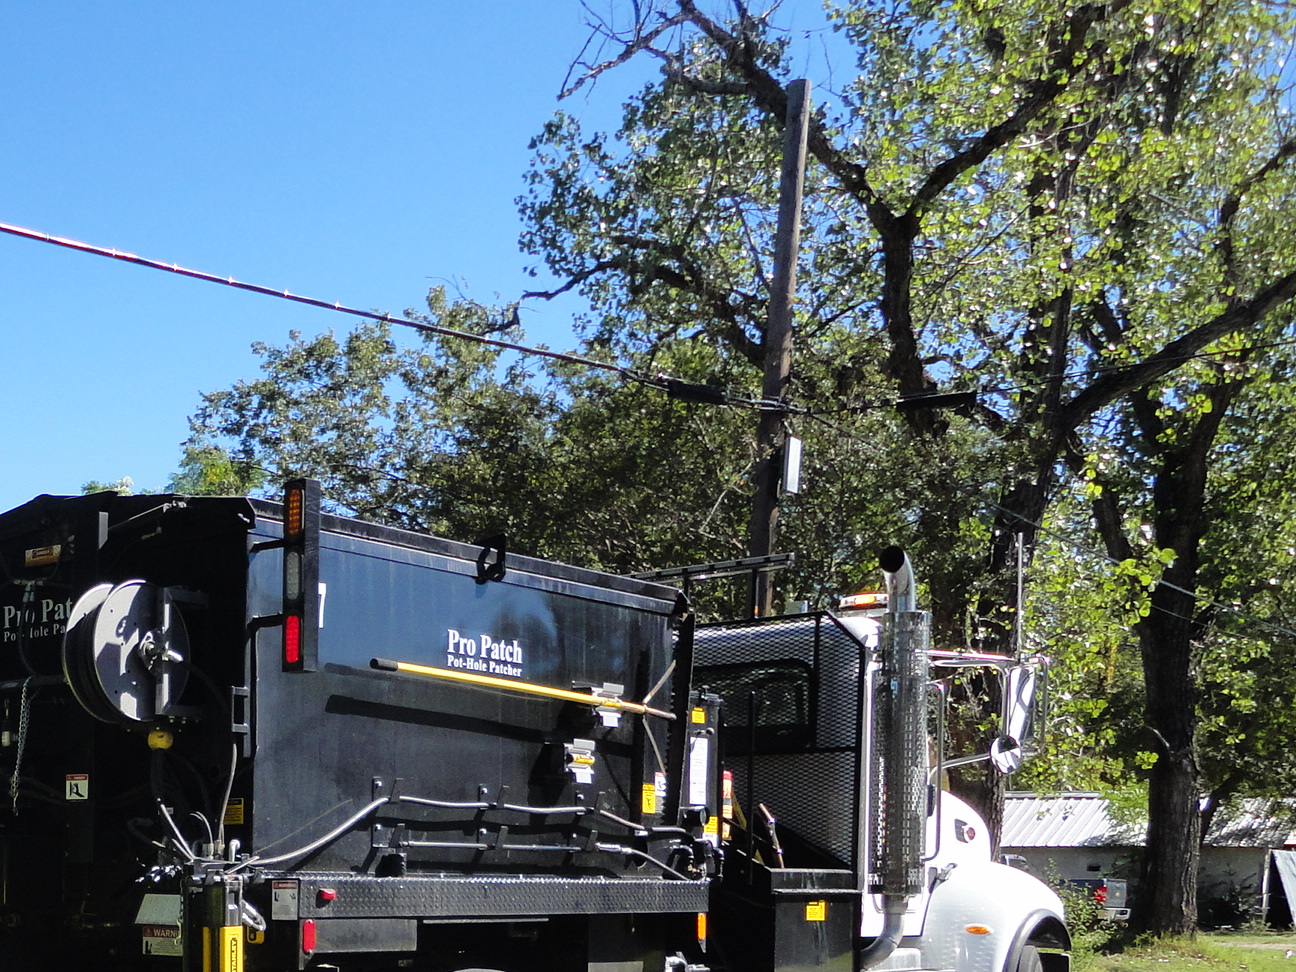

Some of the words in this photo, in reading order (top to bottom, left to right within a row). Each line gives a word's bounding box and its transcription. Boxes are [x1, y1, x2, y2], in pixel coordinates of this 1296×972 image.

[3, 605, 36, 629] Pro
[41, 597, 73, 623] Pat
[447, 629, 477, 657] Pro
[480, 634, 523, 664] Patch
[447, 655, 488, 672] Pot-Hole
[489, 661, 523, 677] Patcher
